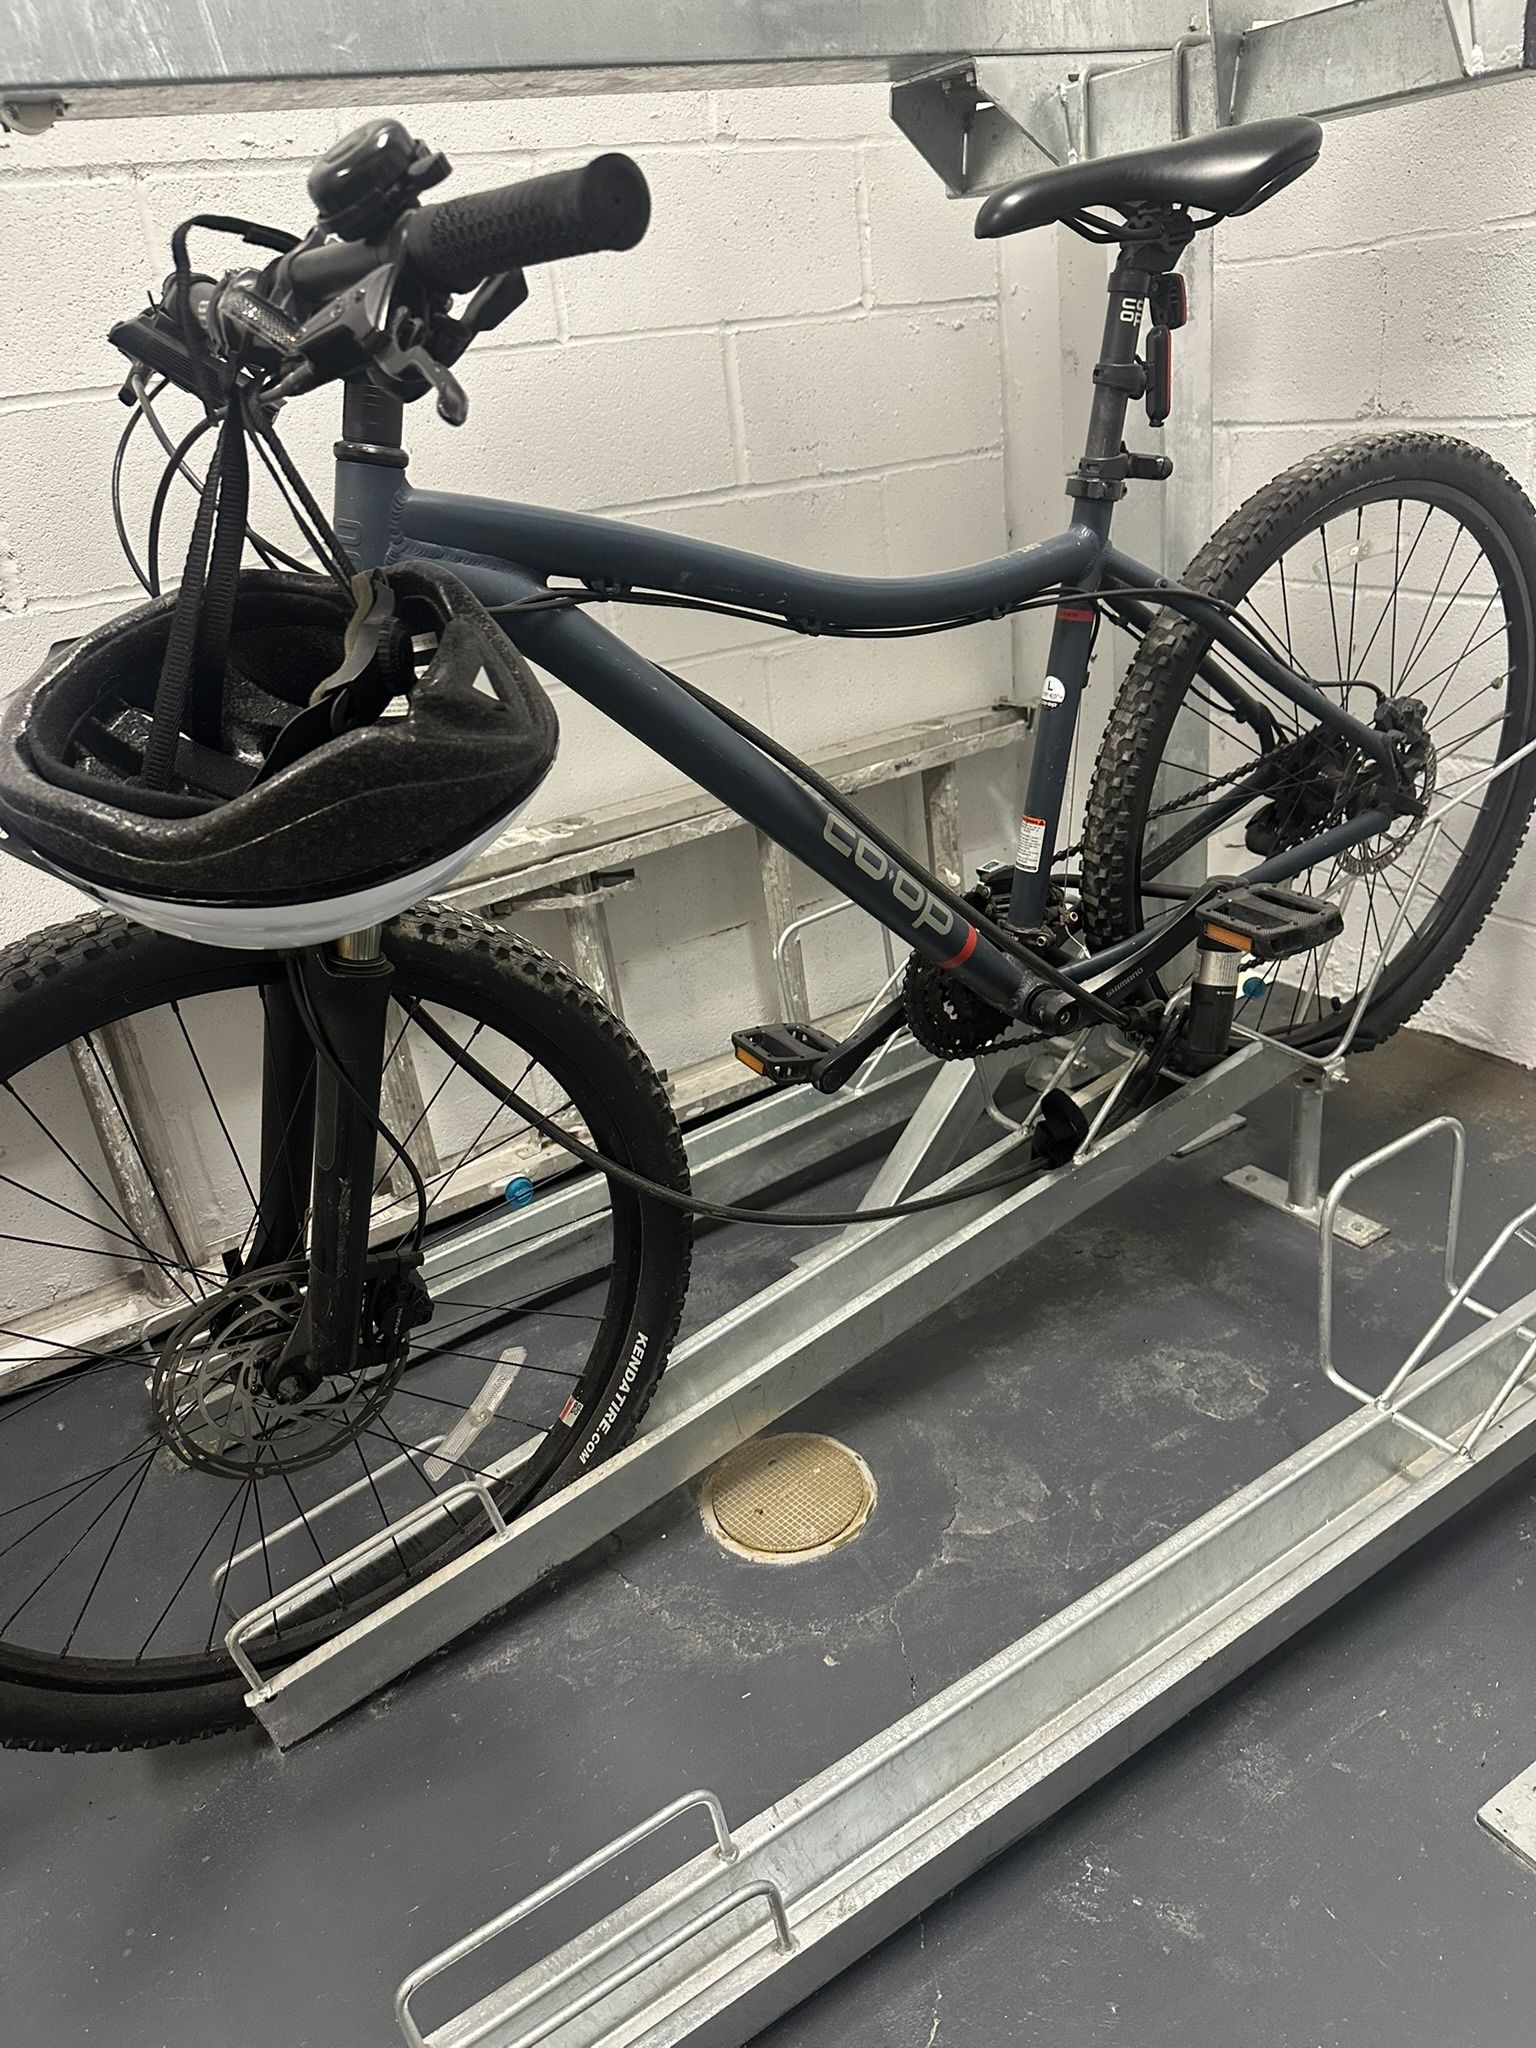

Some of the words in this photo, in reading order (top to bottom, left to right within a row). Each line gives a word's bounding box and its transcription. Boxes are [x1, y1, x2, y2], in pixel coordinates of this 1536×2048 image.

[1047, 680, 1054, 691] L
[1105, 966, 1144, 998] SHIMANO
[579, 1331, 649, 1465] KENDATIRE.COM
